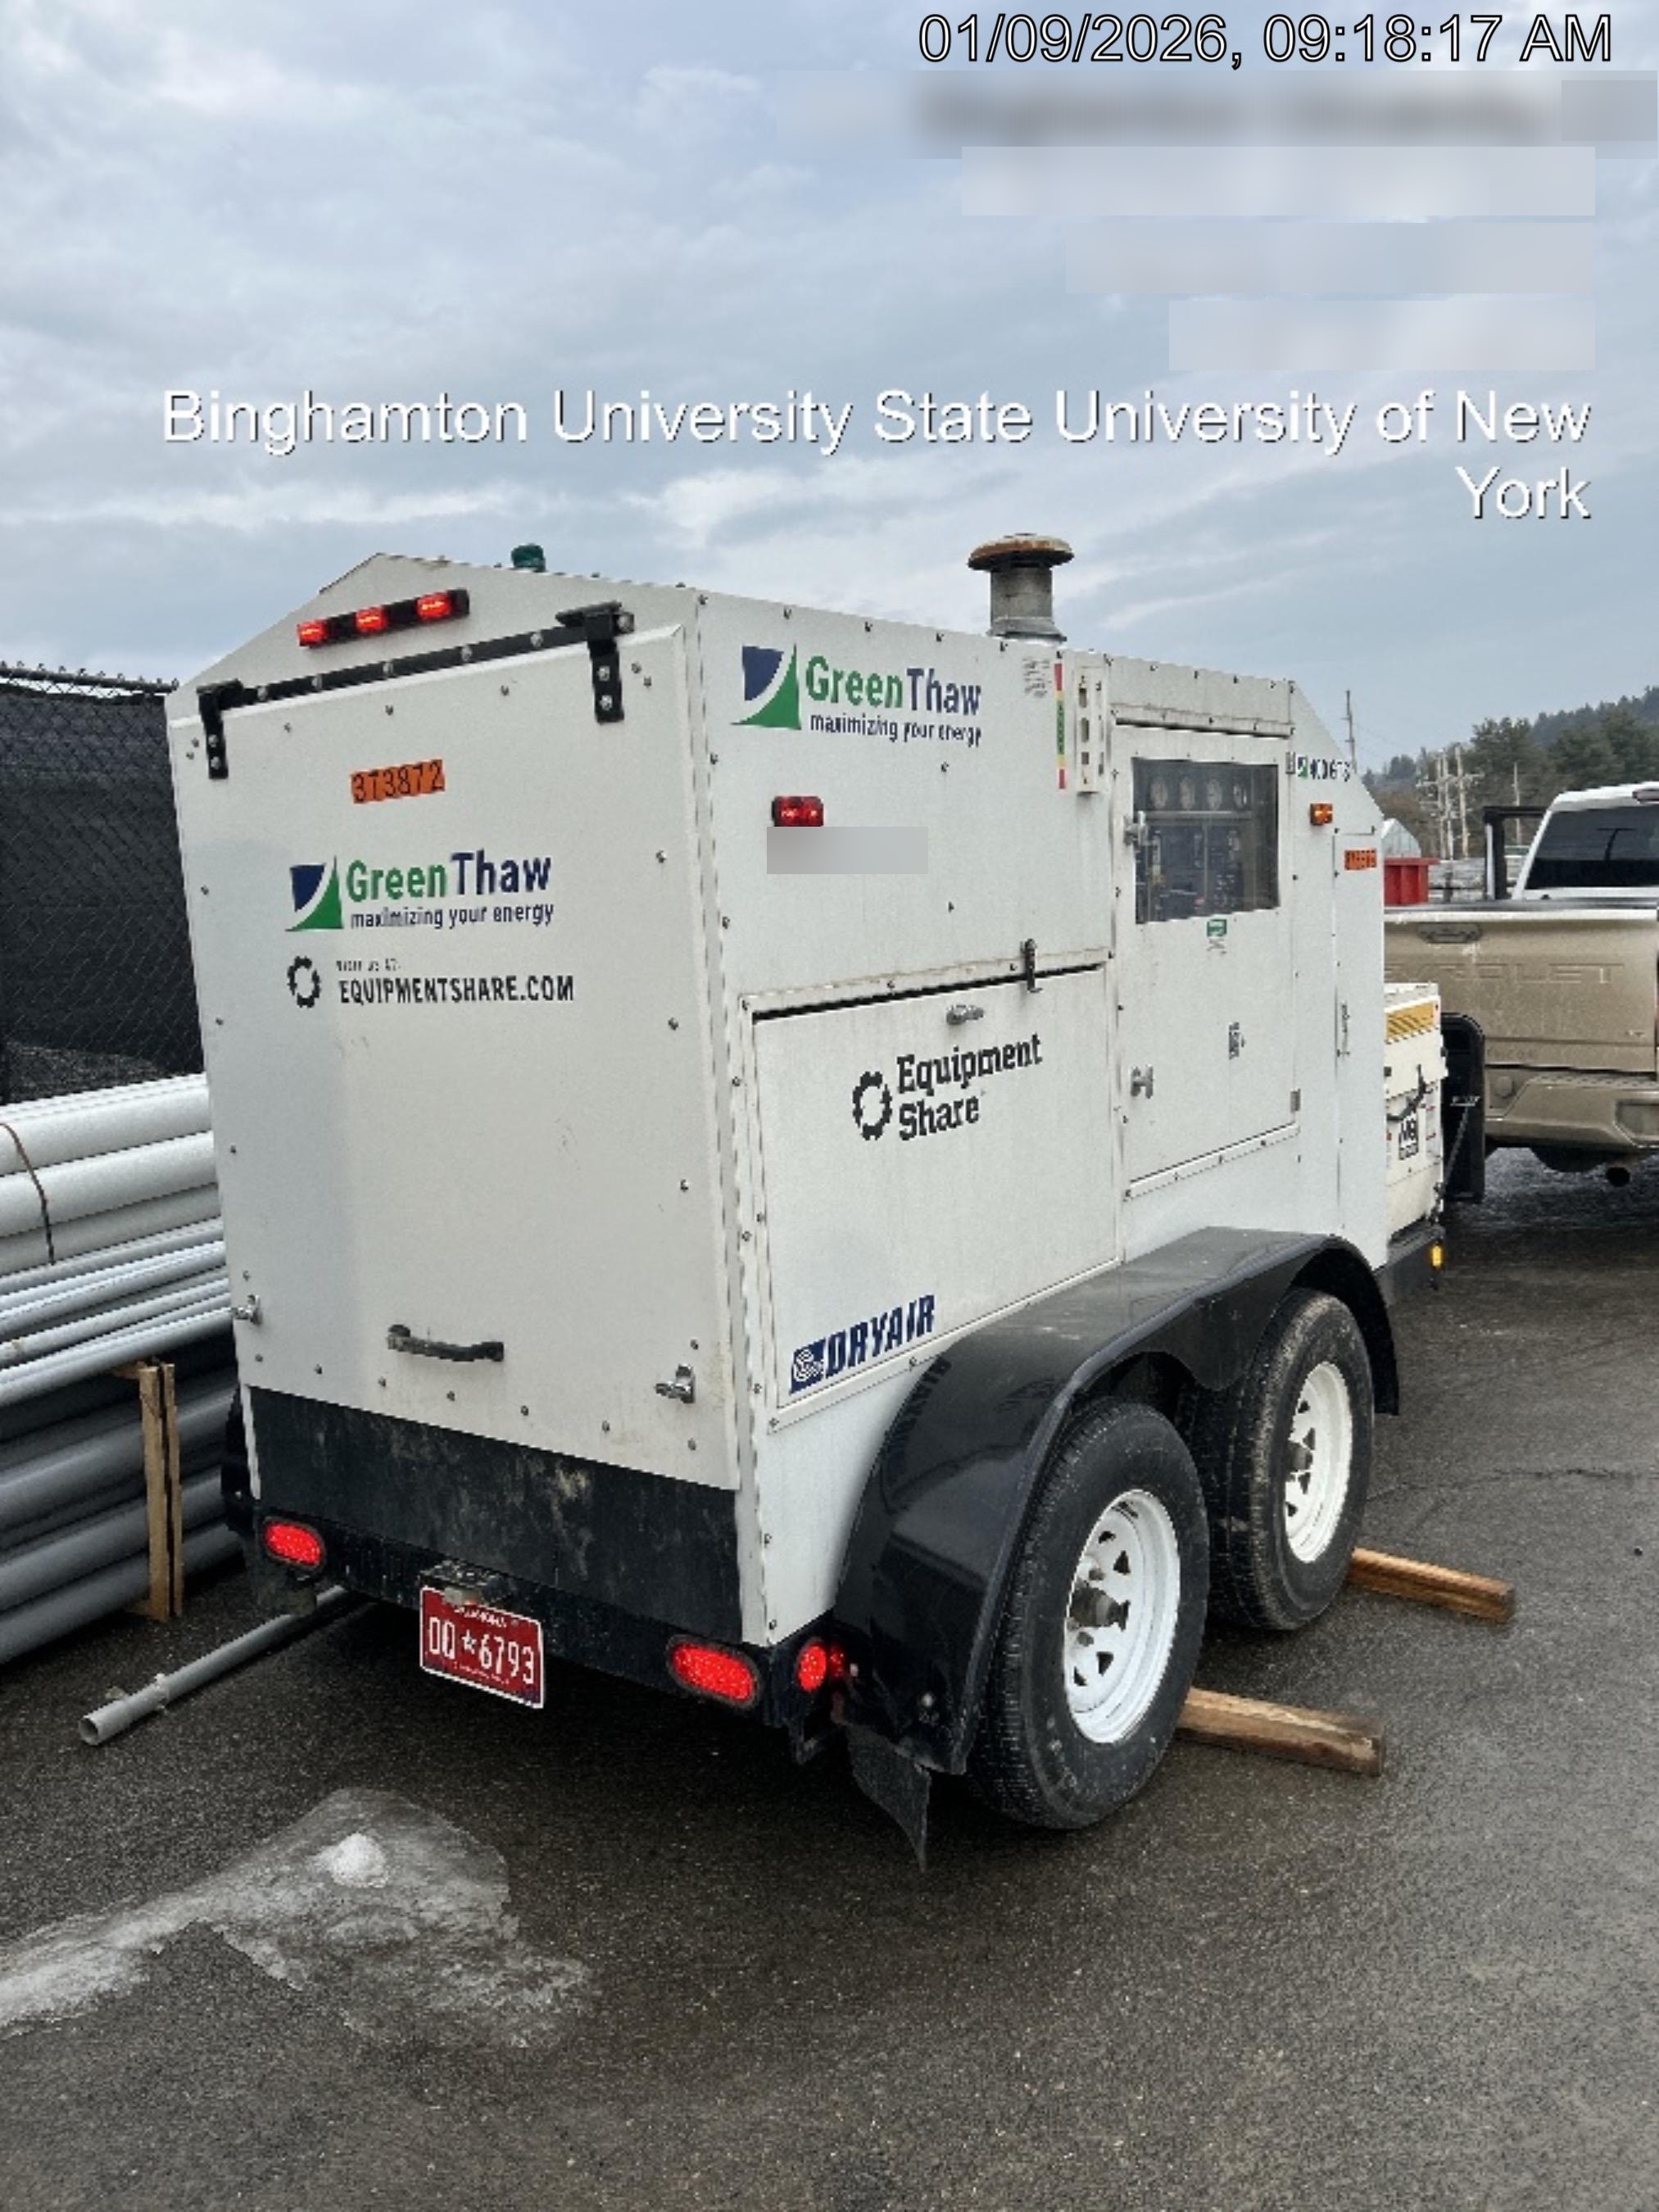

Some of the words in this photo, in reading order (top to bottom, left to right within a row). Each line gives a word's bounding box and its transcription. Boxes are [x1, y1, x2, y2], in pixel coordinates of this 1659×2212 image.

[805, 655, 981, 716] GreenThaw
[809, 713, 899, 743] maximizing
[904, 720, 935, 744] your
[939, 723, 982, 747] energy
[351, 759, 444, 804] 373872
[346, 848, 552, 903] GreenThaw
[351, 905, 444, 931] maximizing
[449, 905, 488, 931] your
[493, 903, 554, 927] energy
[339, 974, 575, 1006] EQUIPMENTSHARE.COM
[896, 1031, 1043, 1096] Equipment
[899, 1095, 980, 1141] Share
[825, 1293, 936, 1380] DRYAIR
[479, 1633, 534, 1684] 6793
